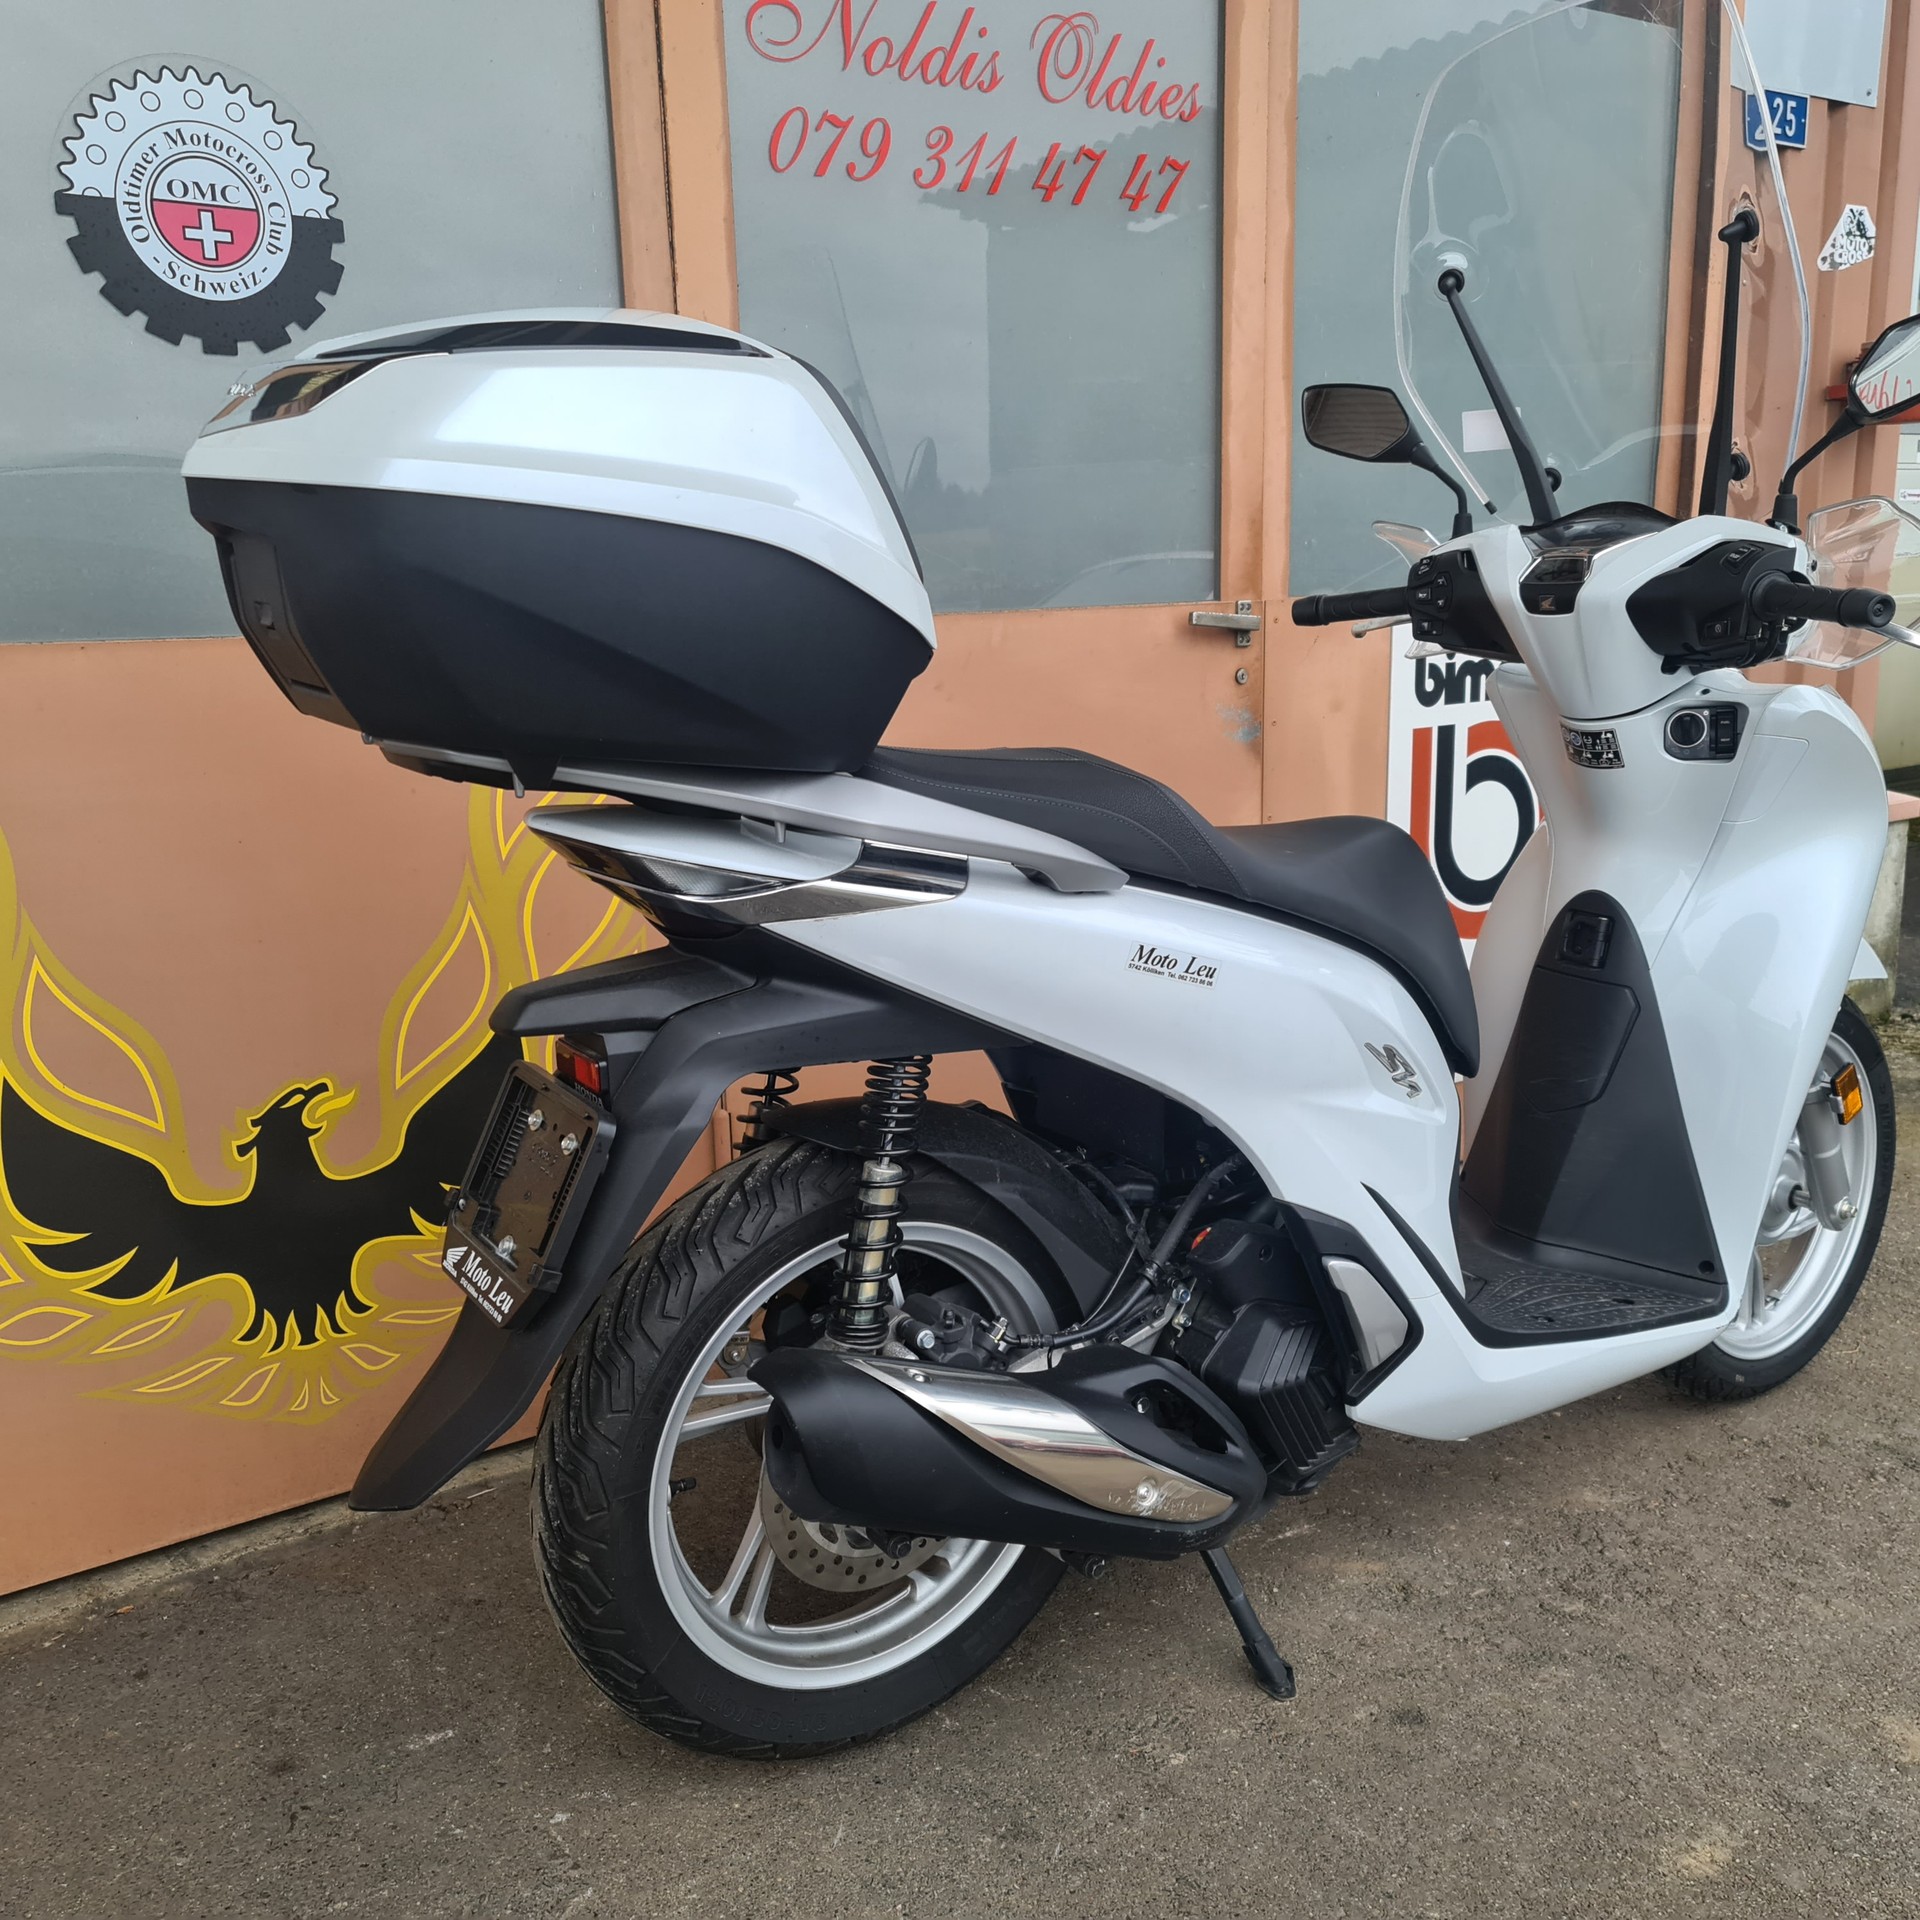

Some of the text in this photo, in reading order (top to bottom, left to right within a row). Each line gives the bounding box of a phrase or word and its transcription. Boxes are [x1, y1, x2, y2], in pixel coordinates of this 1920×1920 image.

[745, 0, 1203, 122] Noldis Oldies
[768, 106, 1191, 213] 079 311 47 47
[123, 128, 287, 256] Oldtimer Motocross Club
[166, 178, 241, 204] OMC
[162, 260, 262, 295] Schweiz
[1415, 652, 1495, 708] bim
[1128, 963, 1142, 971] 5742
[1130, 944, 1217, 979] Moto Leu
[461, 1250, 492, 1291] Moto
[488, 1276, 514, 1314] Leu
